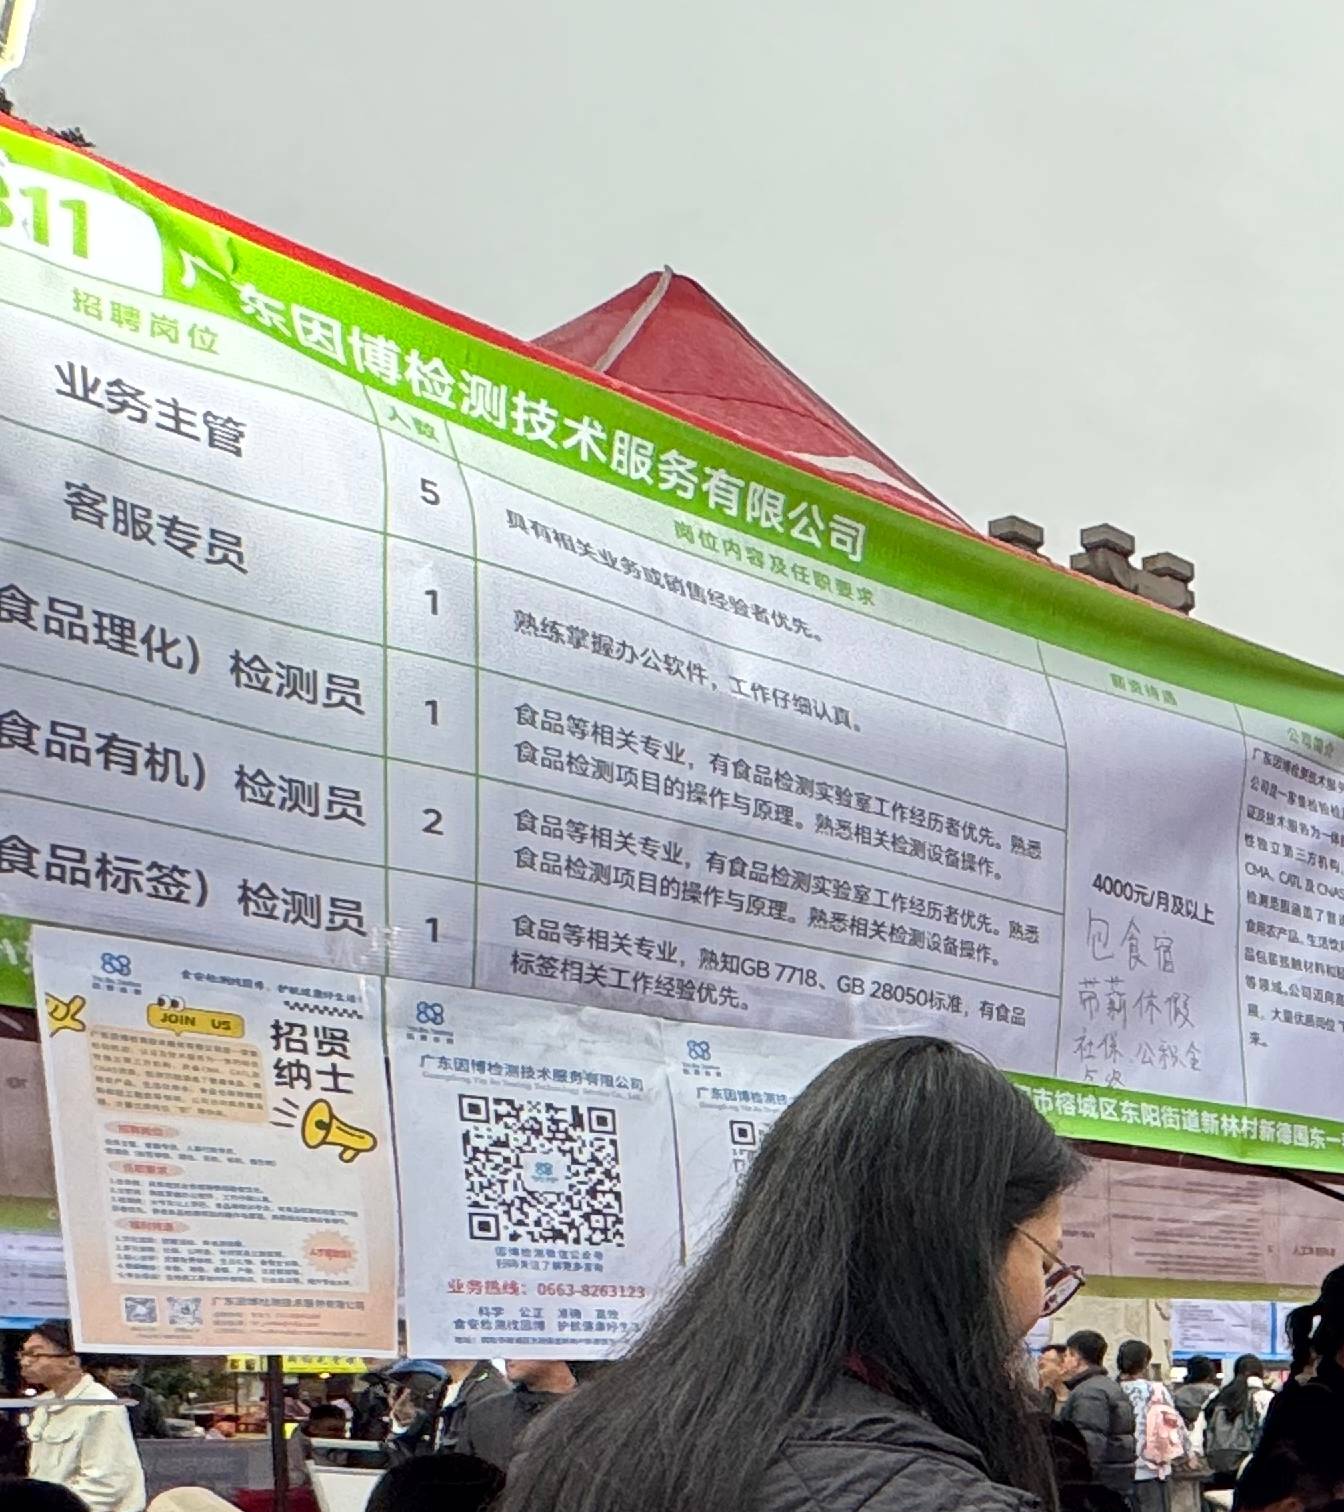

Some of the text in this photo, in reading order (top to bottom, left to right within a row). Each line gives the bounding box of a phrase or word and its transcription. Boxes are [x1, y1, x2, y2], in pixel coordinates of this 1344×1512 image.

[72, 286, 221, 356] 招聘岗位
[55, 361, 248, 459] 业务主管
[180, 249, 868, 563] 广东因博检测技术服务有限公司
[420, 477, 441, 507] 5
[63, 480, 249, 576] 客服专员
[673, 519, 876, 607] 岗位内容及任职要求
[424, 589, 439, 616] 1
[505, 507, 824, 643] 具有相关业务或销售经验者优先。
[513, 608, 863, 733] 熟练掌握办公软件，工作仔细认真。
[424, 699, 439, 726] 1
[513, 738, 1003, 881] 食品检测项目的操作与原理。熟悉相关检测设备操作。
[514, 701, 1044, 861] 食品等相关专业，有食品检测实验室工作经历者优先。熟悉
[421, 808, 445, 836] 2
[512, 845, 1001, 966] 食品检测项目的操作与原理。熟悉相关检测设备操作。
[514, 807, 1041, 946] 食品等相关专业，有食品检测实验室工作经历者优先。熟悉
[1091, 873, 1216, 926] 4000元/月及以上
[424, 917, 439, 943] 1
[508, 951, 752, 1012] 标签相关工作经验优先。
[160, 1012, 232, 1031] JOIN US
[270, 1018, 351, 1060] 招贤
[272, 1056, 355, 1095] 纳士
